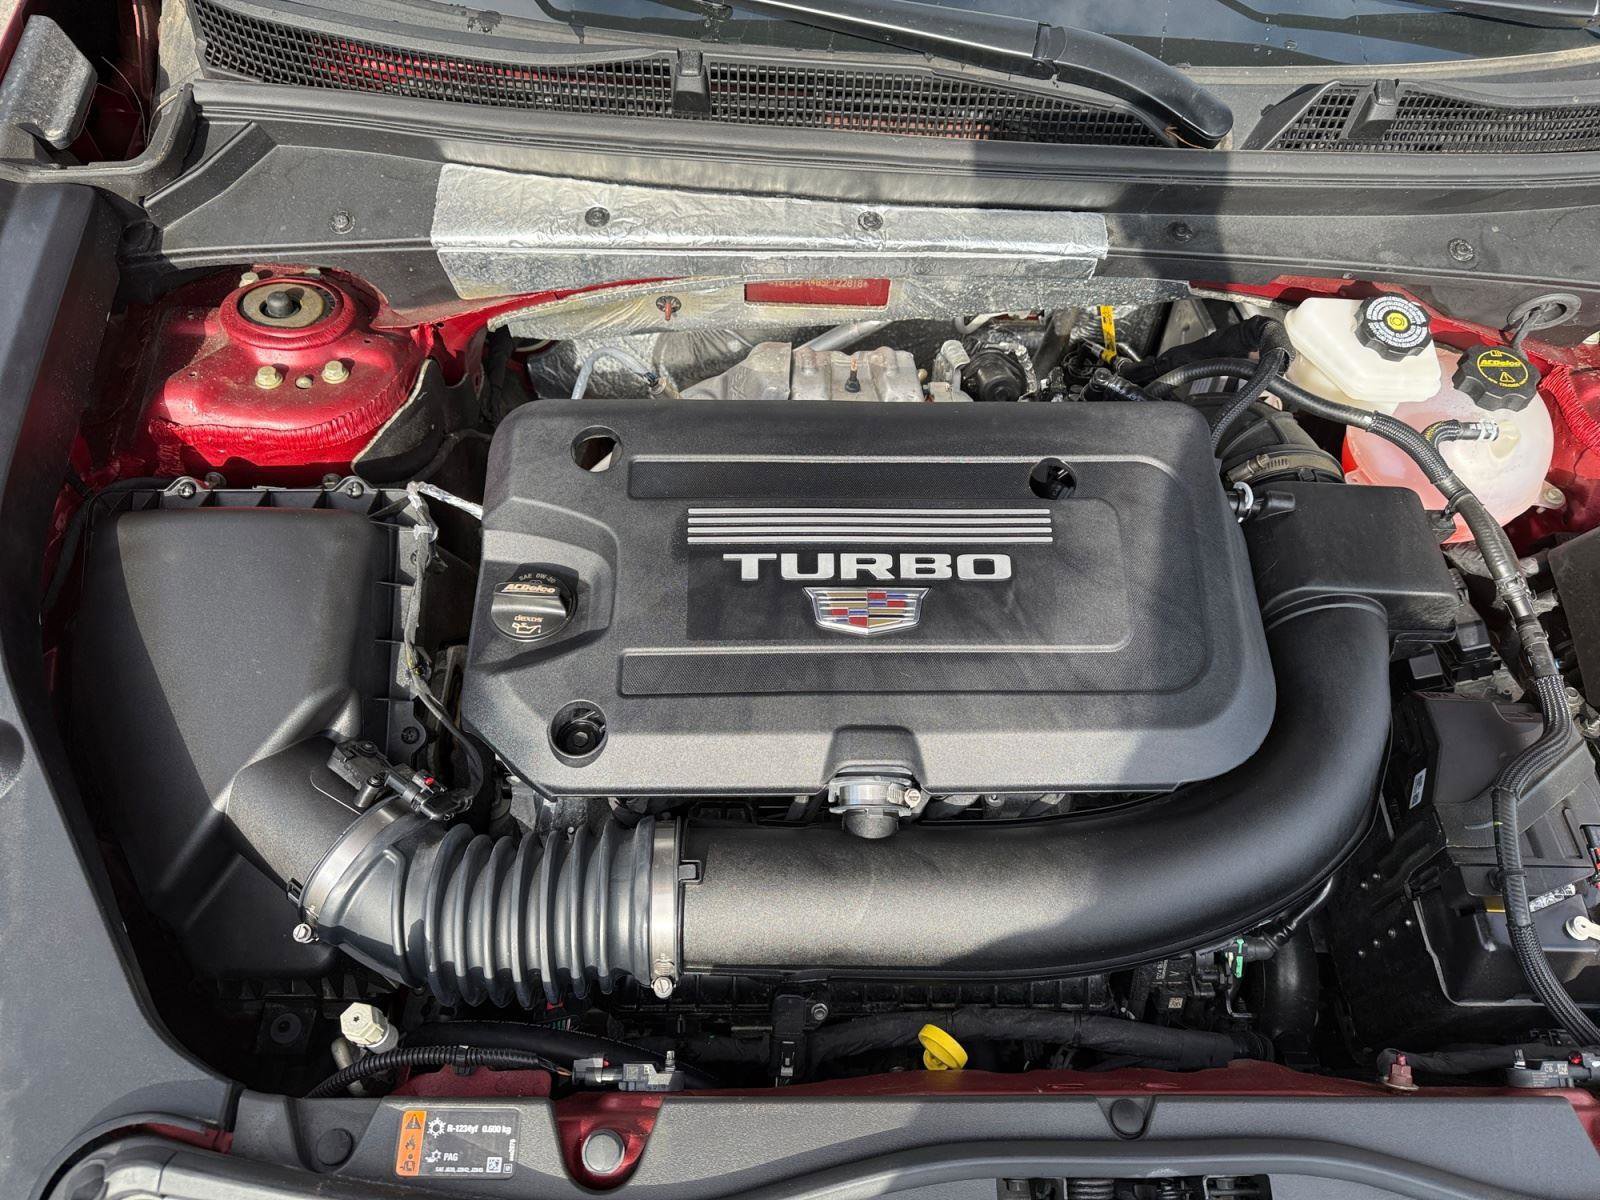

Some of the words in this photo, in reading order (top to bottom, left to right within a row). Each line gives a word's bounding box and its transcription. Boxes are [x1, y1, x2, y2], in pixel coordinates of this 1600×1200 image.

[1480, 359, 1522, 367] ACDelco
[722, 553, 1012, 582] TURBO
[501, 583, 556, 593] ACDelco
[447, 1124, 478, 1134] R-1234yf
[502, 1125, 512, 1134] kg
[444, 1153, 458, 1161] PAG
